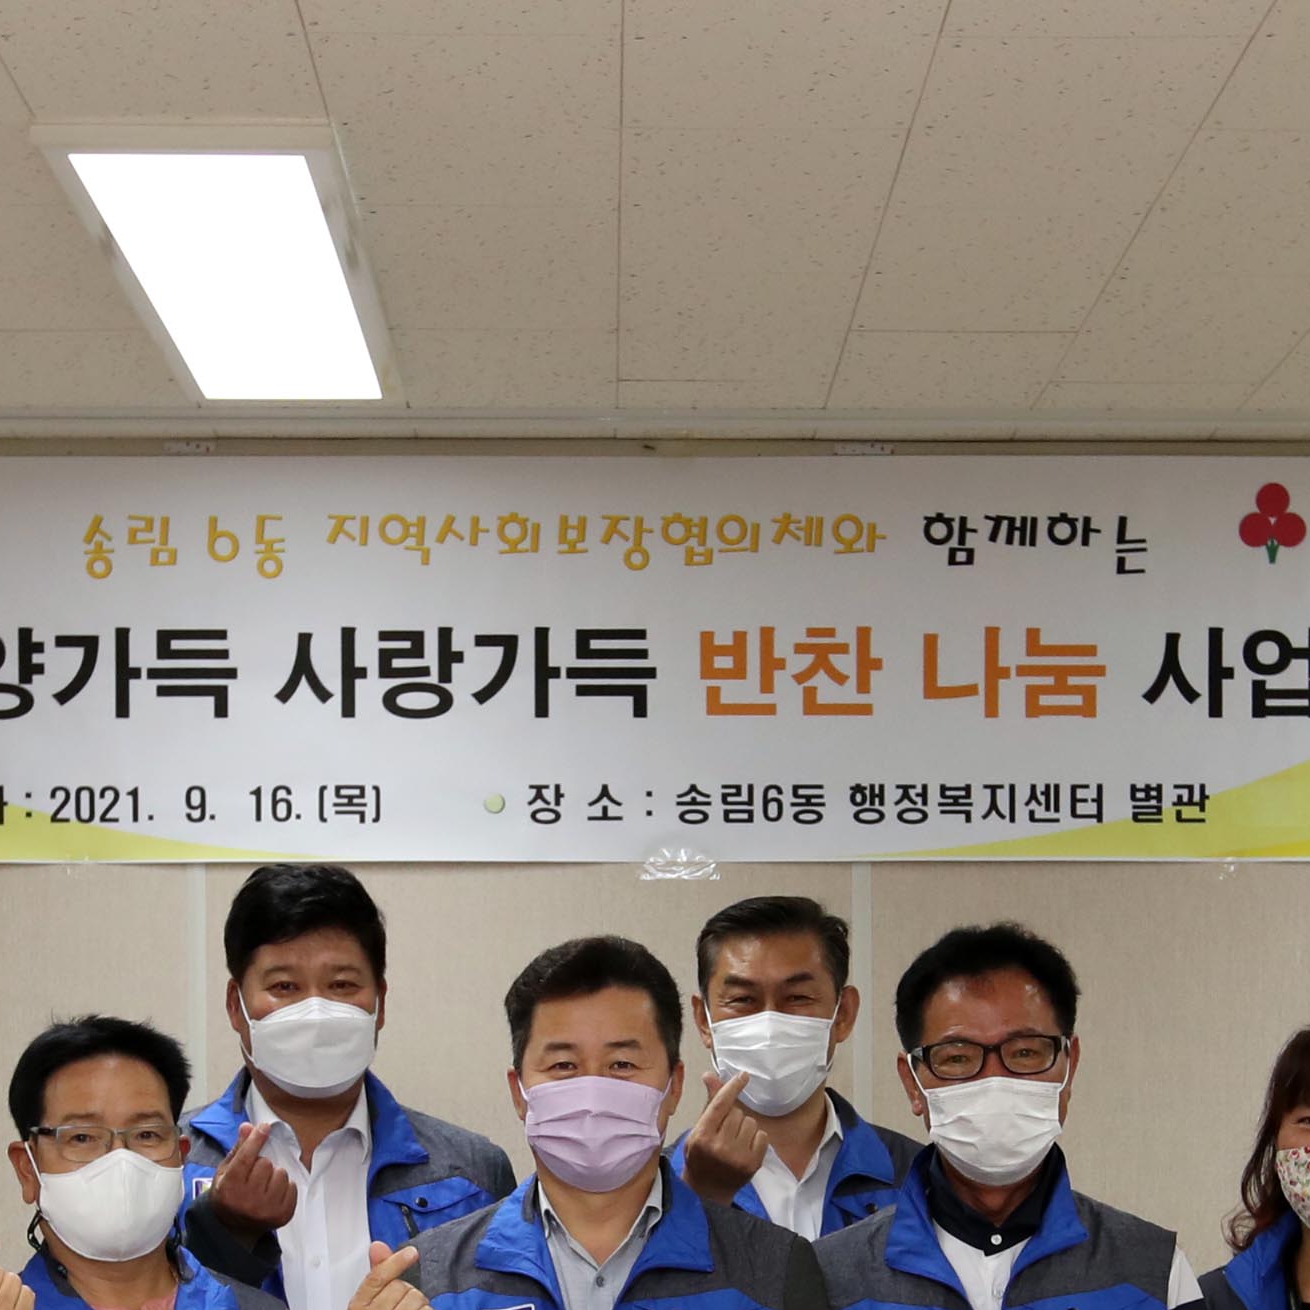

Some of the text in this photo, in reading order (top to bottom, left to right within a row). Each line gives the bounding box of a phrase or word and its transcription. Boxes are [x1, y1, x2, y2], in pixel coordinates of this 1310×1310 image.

[81, 512, 178, 579] 송림
[325, 511, 886, 572] 지역사회보장협의체와
[921, 511, 1149, 575] 함께하는
[274, 626, 658, 721] 사랑가득
[698, 624, 885, 719] 반찬
[921, 624, 1108, 719] 나눔
[49, 785, 154, 825] 2021.
[185, 785, 216, 824] 9.
[675, 783, 827, 826] 송림6동
[849, 783, 1106, 826] 행정복지센터
[1128, 783, 1211, 826] 별관
